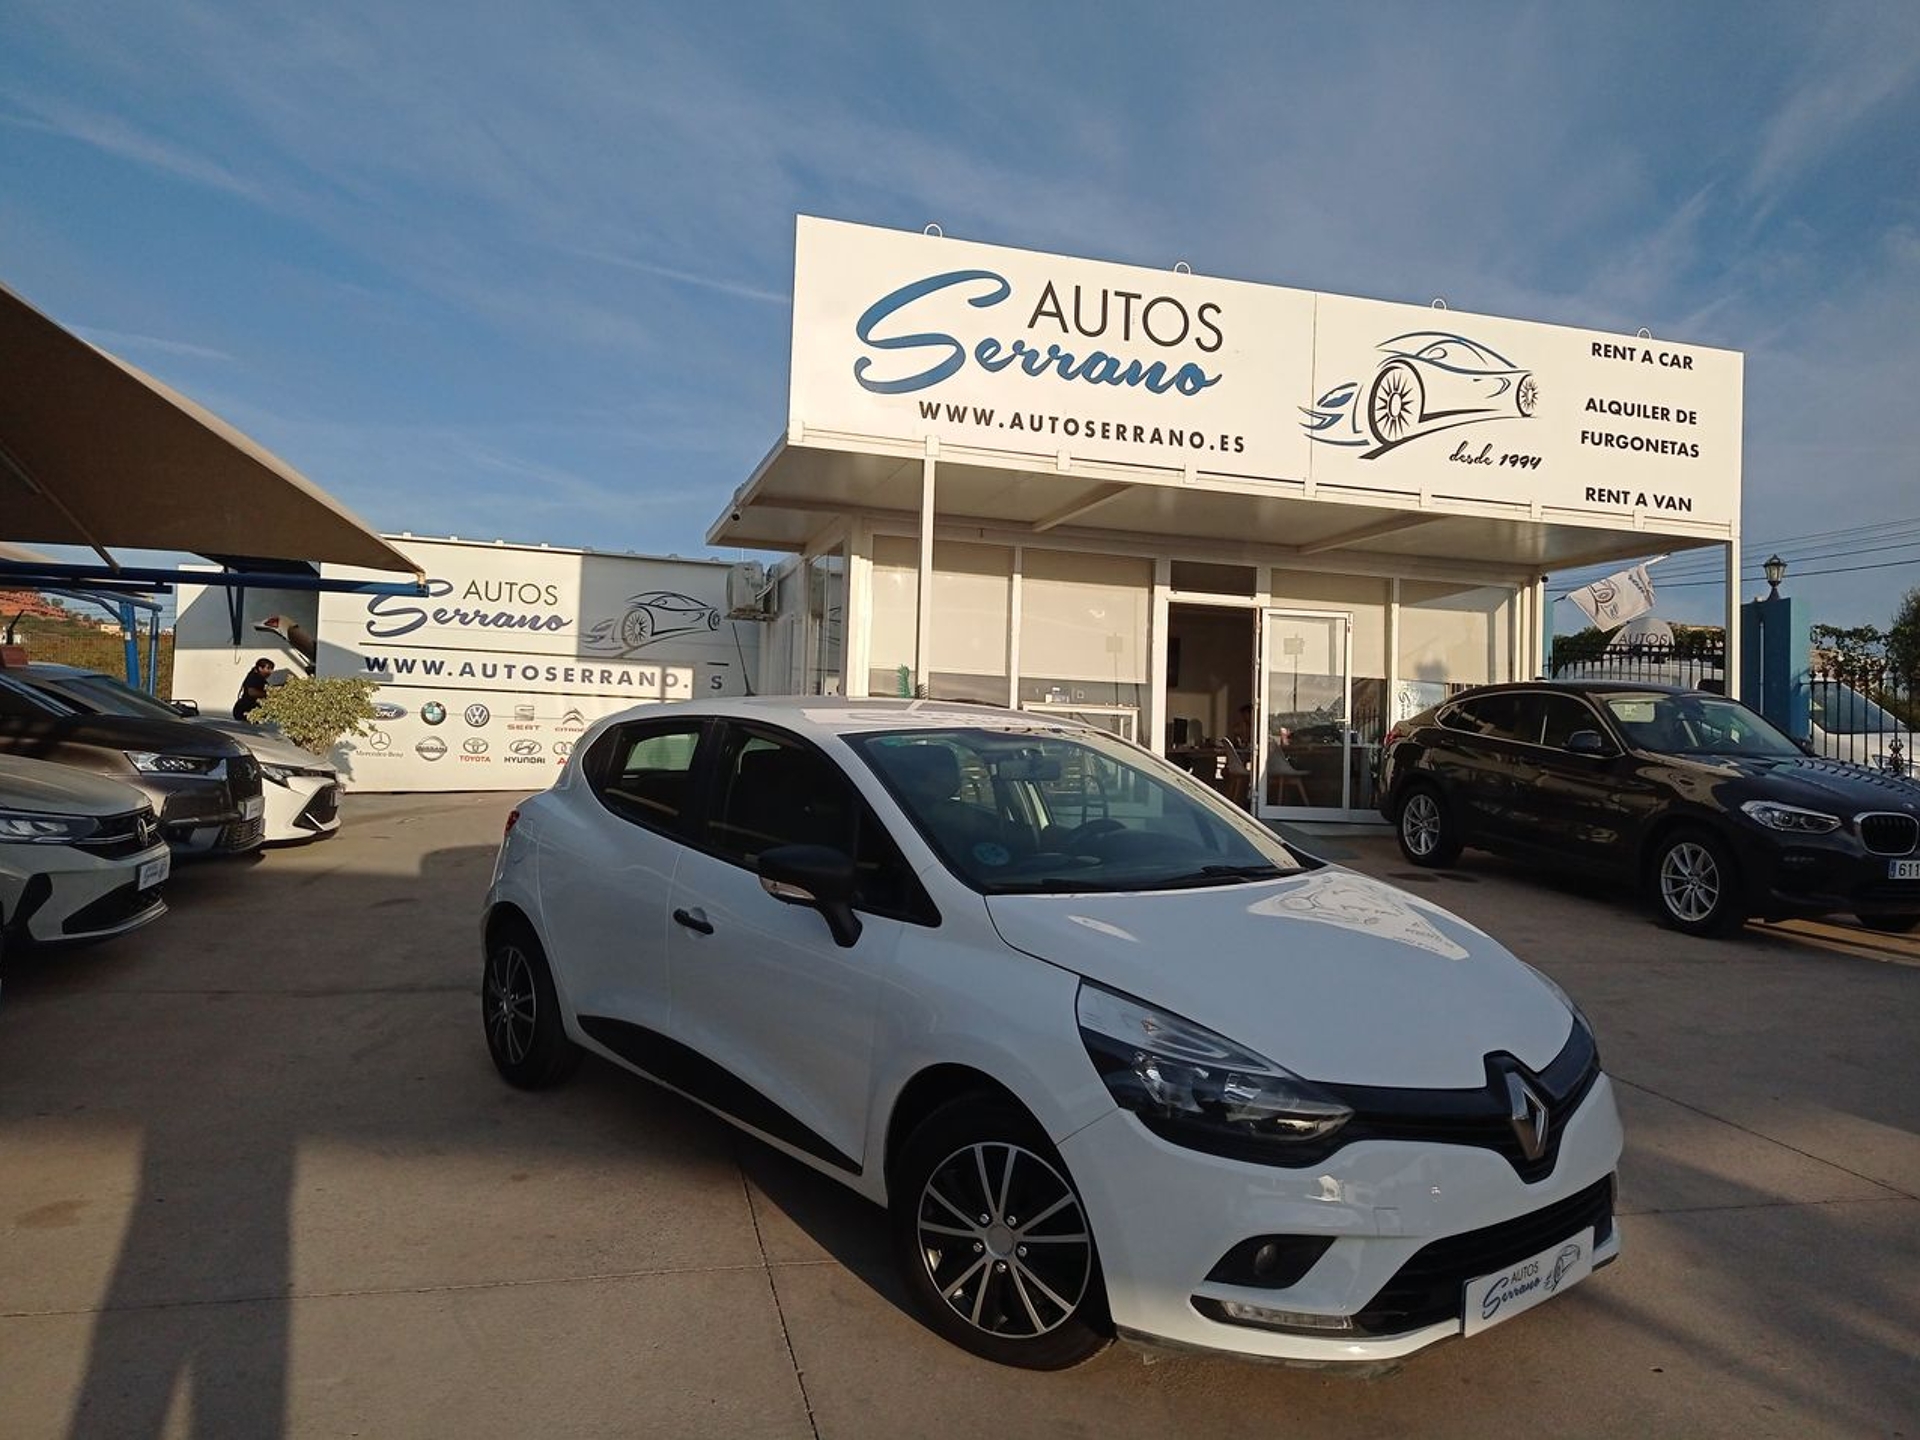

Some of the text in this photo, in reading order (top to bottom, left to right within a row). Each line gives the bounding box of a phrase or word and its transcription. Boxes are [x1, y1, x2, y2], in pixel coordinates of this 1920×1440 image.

[1028, 279, 1223, 353] AUTOS
[854, 269, 1223, 397] Serrano
[1591, 342, 1693, 371] RENT A CAR
[1585, 397, 1697, 426] ALQUILER DE
[919, 400, 1245, 454] WWW.AUTOSERRANO.ES
[1449, 440, 1542, 470] desde 1994
[1580, 430, 1700, 458] FURGONETAS
[1585, 486, 1692, 513] RENT A VAN
[462, 579, 559, 606] AUTOS
[366, 578, 572, 638] Serrano
[365, 656, 723, 691] WWW.AUTOSERRANO.S
[507, 723, 541, 732] SEAT
[459, 755, 491, 764] TOYOTA
[504, 756, 546, 765] HYUNDAI
[1511, 1261, 1540, 1284] AUTOS
[1482, 1276, 1541, 1320] Serrano
